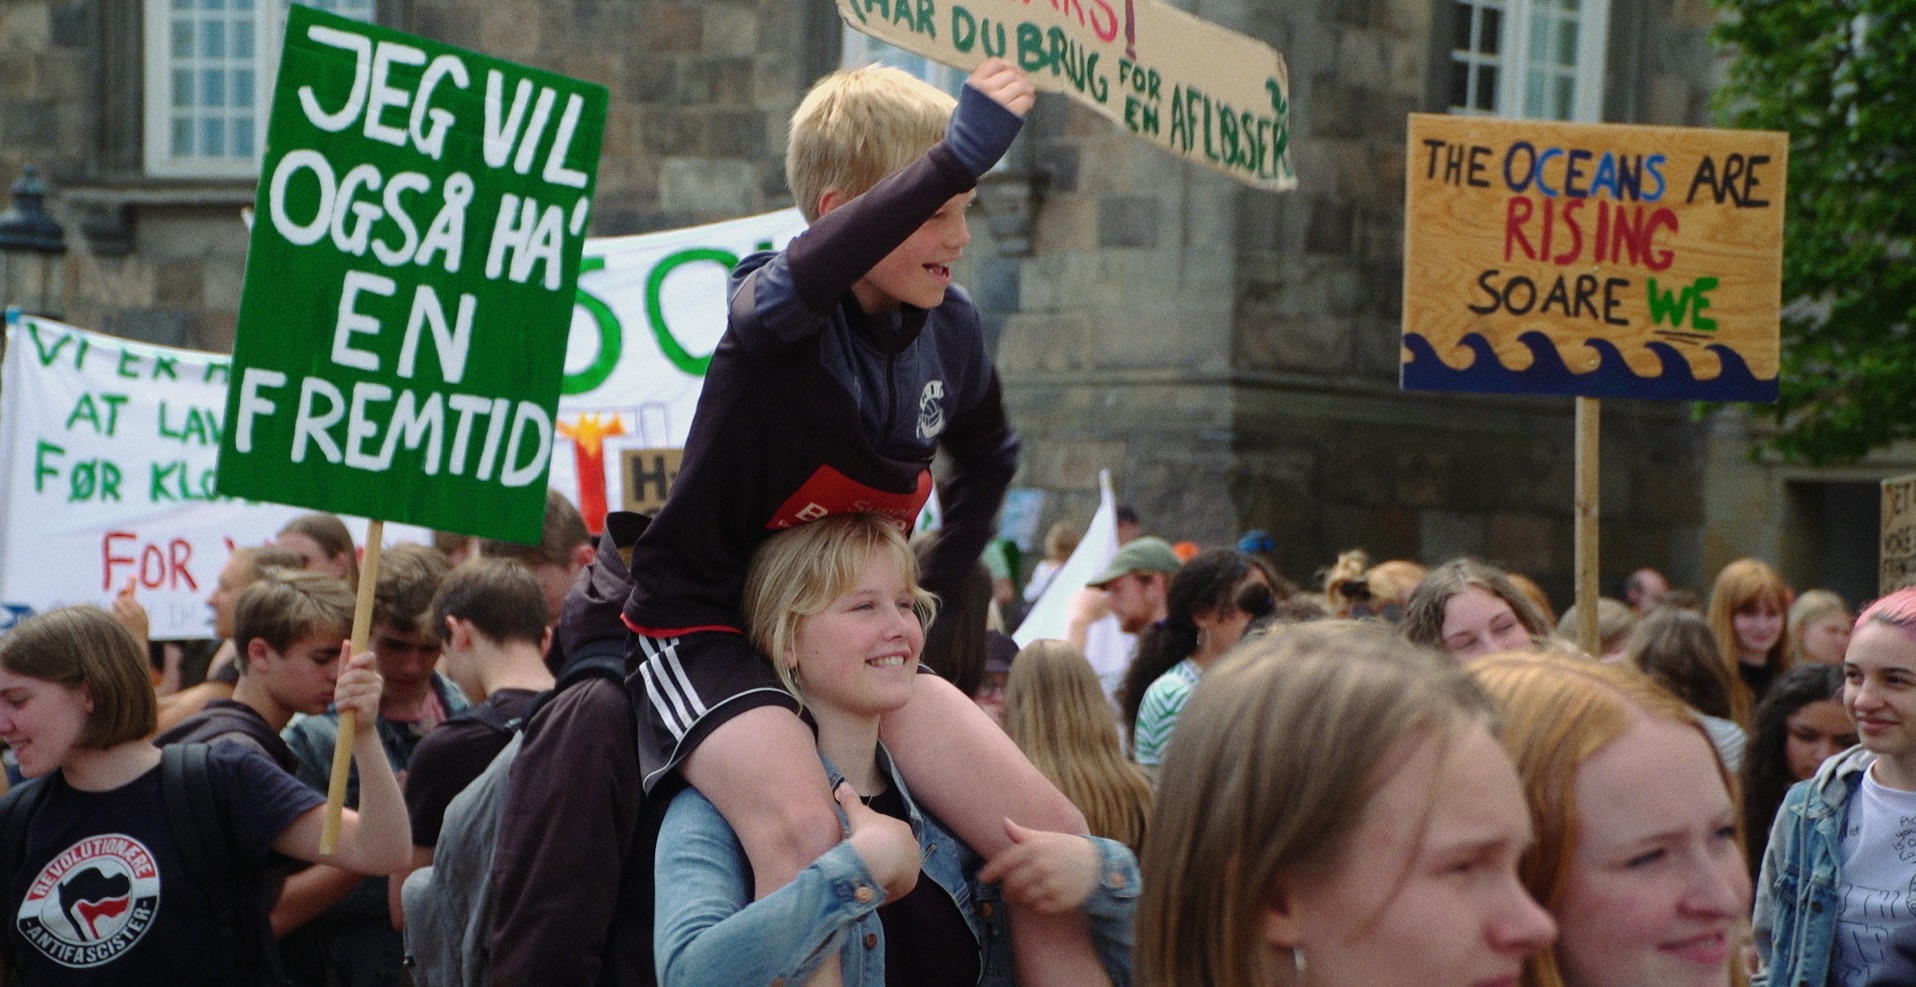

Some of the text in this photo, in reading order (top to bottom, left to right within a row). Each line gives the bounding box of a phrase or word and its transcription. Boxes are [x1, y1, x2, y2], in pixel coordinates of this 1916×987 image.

[952, 6, 1006, 58] DU
[1016, 21, 1108, 104] BRUG
[298, 25, 588, 188] JEG VIL
[1119, 58, 1160, 100] FOR
[1125, 96, 1159, 137] EN
[1423, 139, 1770, 208] THE OCEANS ARE
[270, 149, 589, 291] OGSÅ HA'
[1503, 197, 1678, 271] RISING
[331, 269, 477, 384] EN
[1647, 277, 1719, 331] WE
[26, 322, 88, 370] VI
[66, 393, 128, 437] AT
[235, 367, 551, 487] FREMTID
[35, 438, 121, 502] FØR
[102, 531, 197, 591] FOR
